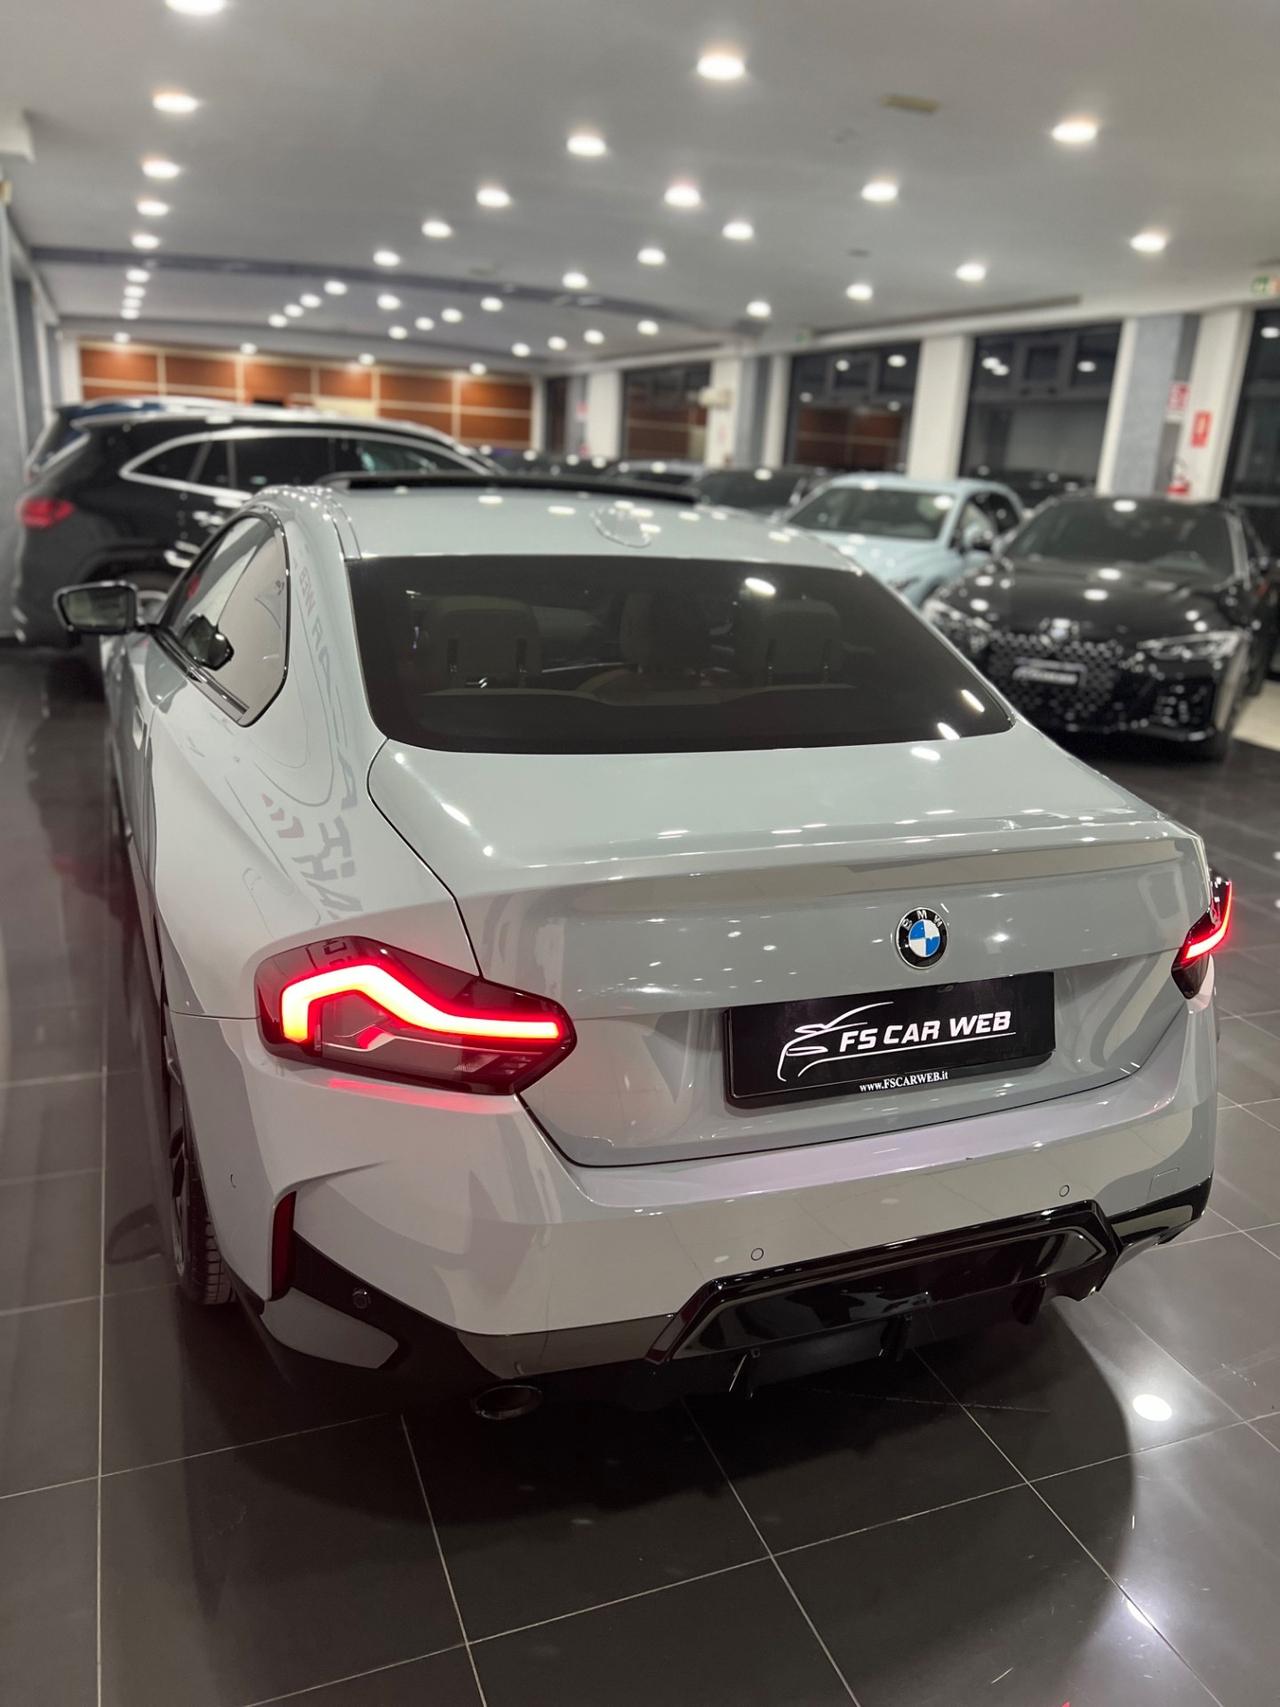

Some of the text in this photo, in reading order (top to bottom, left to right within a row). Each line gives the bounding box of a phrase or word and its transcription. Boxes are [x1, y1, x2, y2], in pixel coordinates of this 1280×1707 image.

[902, 909, 943, 931] BMW
[839, 1010, 1012, 1053] FS CAR WEB
[859, 1070, 949, 1093] www.FSCARWEB.it
